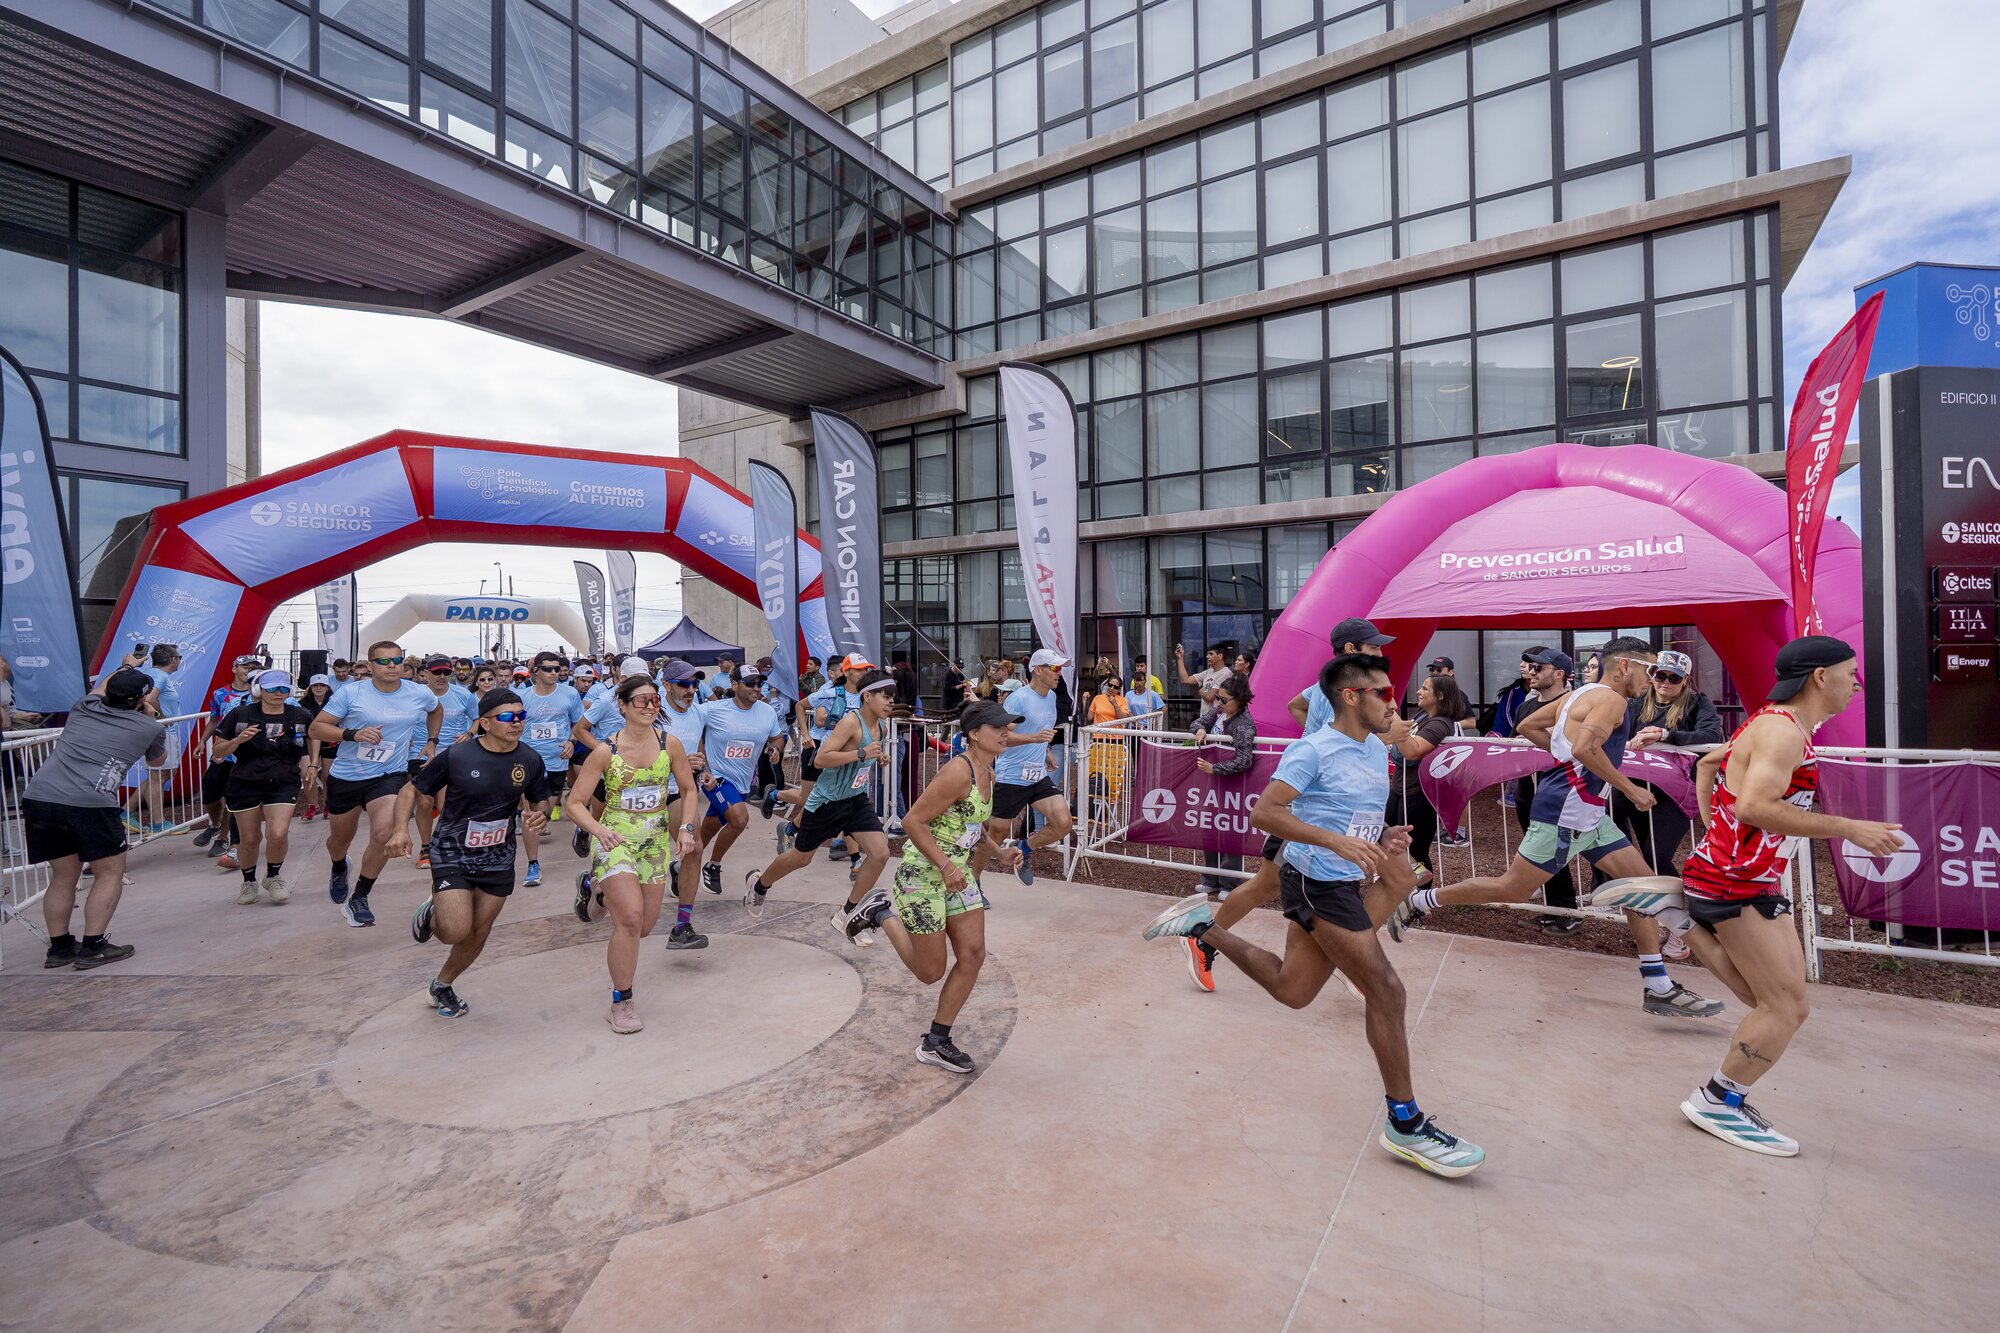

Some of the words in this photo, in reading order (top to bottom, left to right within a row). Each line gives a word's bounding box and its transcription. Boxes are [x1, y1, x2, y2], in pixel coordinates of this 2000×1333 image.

[1940, 392, 1988, 405] EDIFICIO
[1990, 393, 1997, 405] II
[497, 468, 522, 478] Polo
[497, 476, 547, 487] Científico
[569, 480, 645, 497] Corremos
[497, 484, 560, 496] Tecnológico
[497, 499, 521, 507] capital
[569, 493, 588, 504] AL
[591, 495, 645, 509] FUTURO
[286, 501, 372, 518] SANCOR
[286, 516, 372, 532] SEGUROS
[1440, 547, 1591, 569] Prevención
[1598, 535, 1684, 560] Salud
[1483, 571, 1498, 581] de
[1500, 567, 1558, 580] SANCOR
[1560, 564, 1632, 576] SEGUROS
[1960, 575, 1992, 590] cites
[174, 588, 192, 597] Polo
[445, 605, 529, 622] PARDO
[159, 623, 199, 636] SEGUROS
[161, 617, 201, 631] SANCOR
[1959, 658, 1990, 667] Energy
[536, 728, 552, 739] 29
[365, 748, 386, 761] 47
[727, 746, 752, 758] 628
[625, 794, 657, 810] 153
[1184, 809, 1270, 836] SEGU
[468, 828, 505, 847] 550
[1353, 825, 1380, 843] 138
[1940, 824, 2000, 854] SA
[1941, 859, 2000, 889] SE
